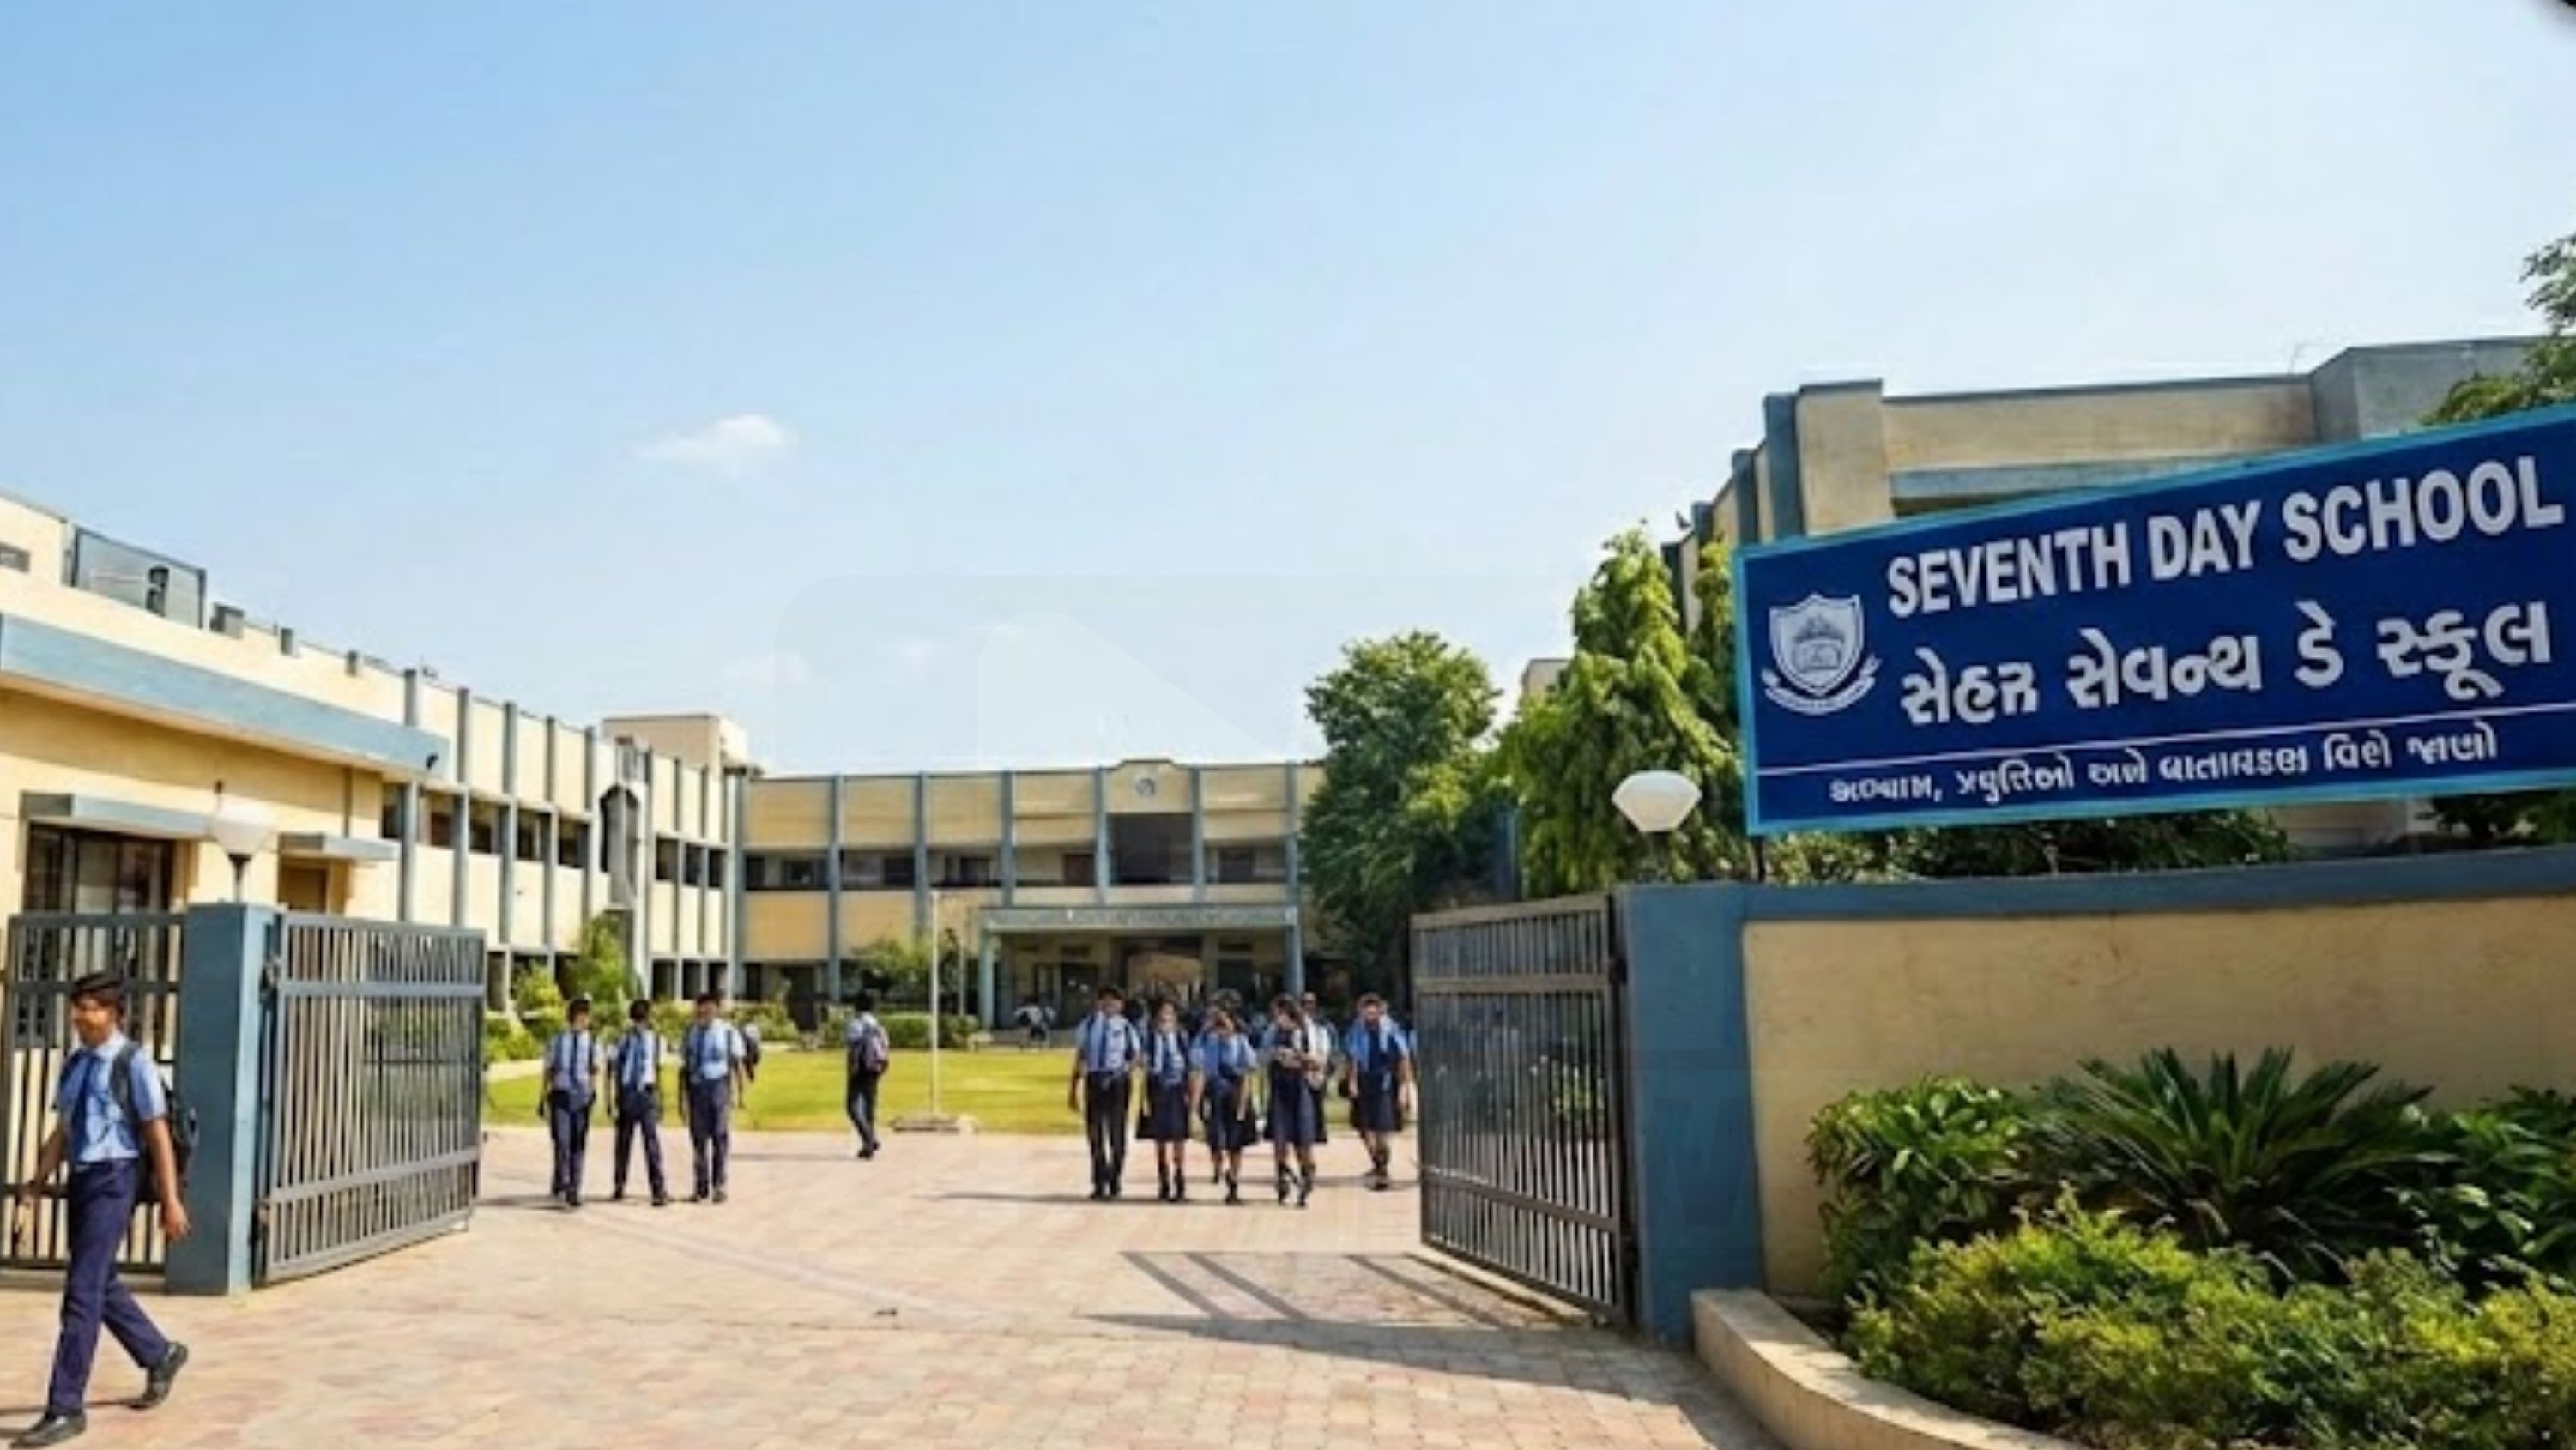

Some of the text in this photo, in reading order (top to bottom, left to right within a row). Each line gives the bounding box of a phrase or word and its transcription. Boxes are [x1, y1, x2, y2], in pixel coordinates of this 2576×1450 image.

[1888, 456, 2565, 618] SEVENTH DAY SCHOOL
[2066, 627, 2263, 708] સેવન્થ
[2293, 600, 2344, 687] ડે
[2376, 601, 2552, 701] સ્કૂલ
